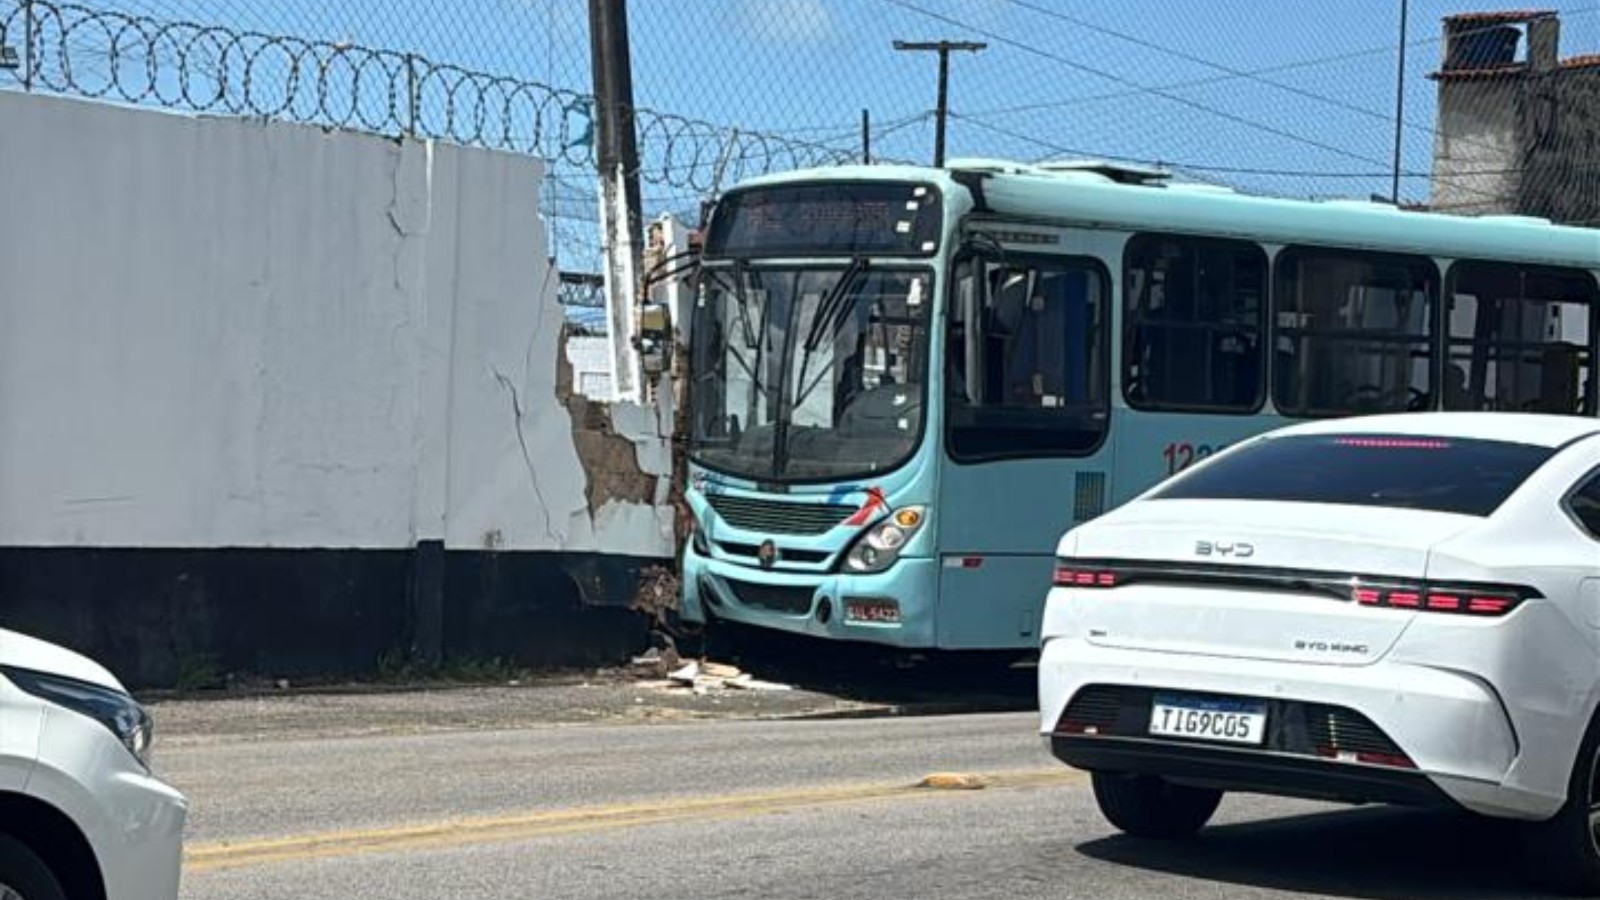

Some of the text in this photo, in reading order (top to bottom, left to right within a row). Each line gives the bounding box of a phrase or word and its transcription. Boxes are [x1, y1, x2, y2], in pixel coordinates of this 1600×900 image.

[1163, 442, 1228, 476] 12
[1195, 540, 1254, 557] BYD
[1162, 709, 1251, 738] TIG9C05
